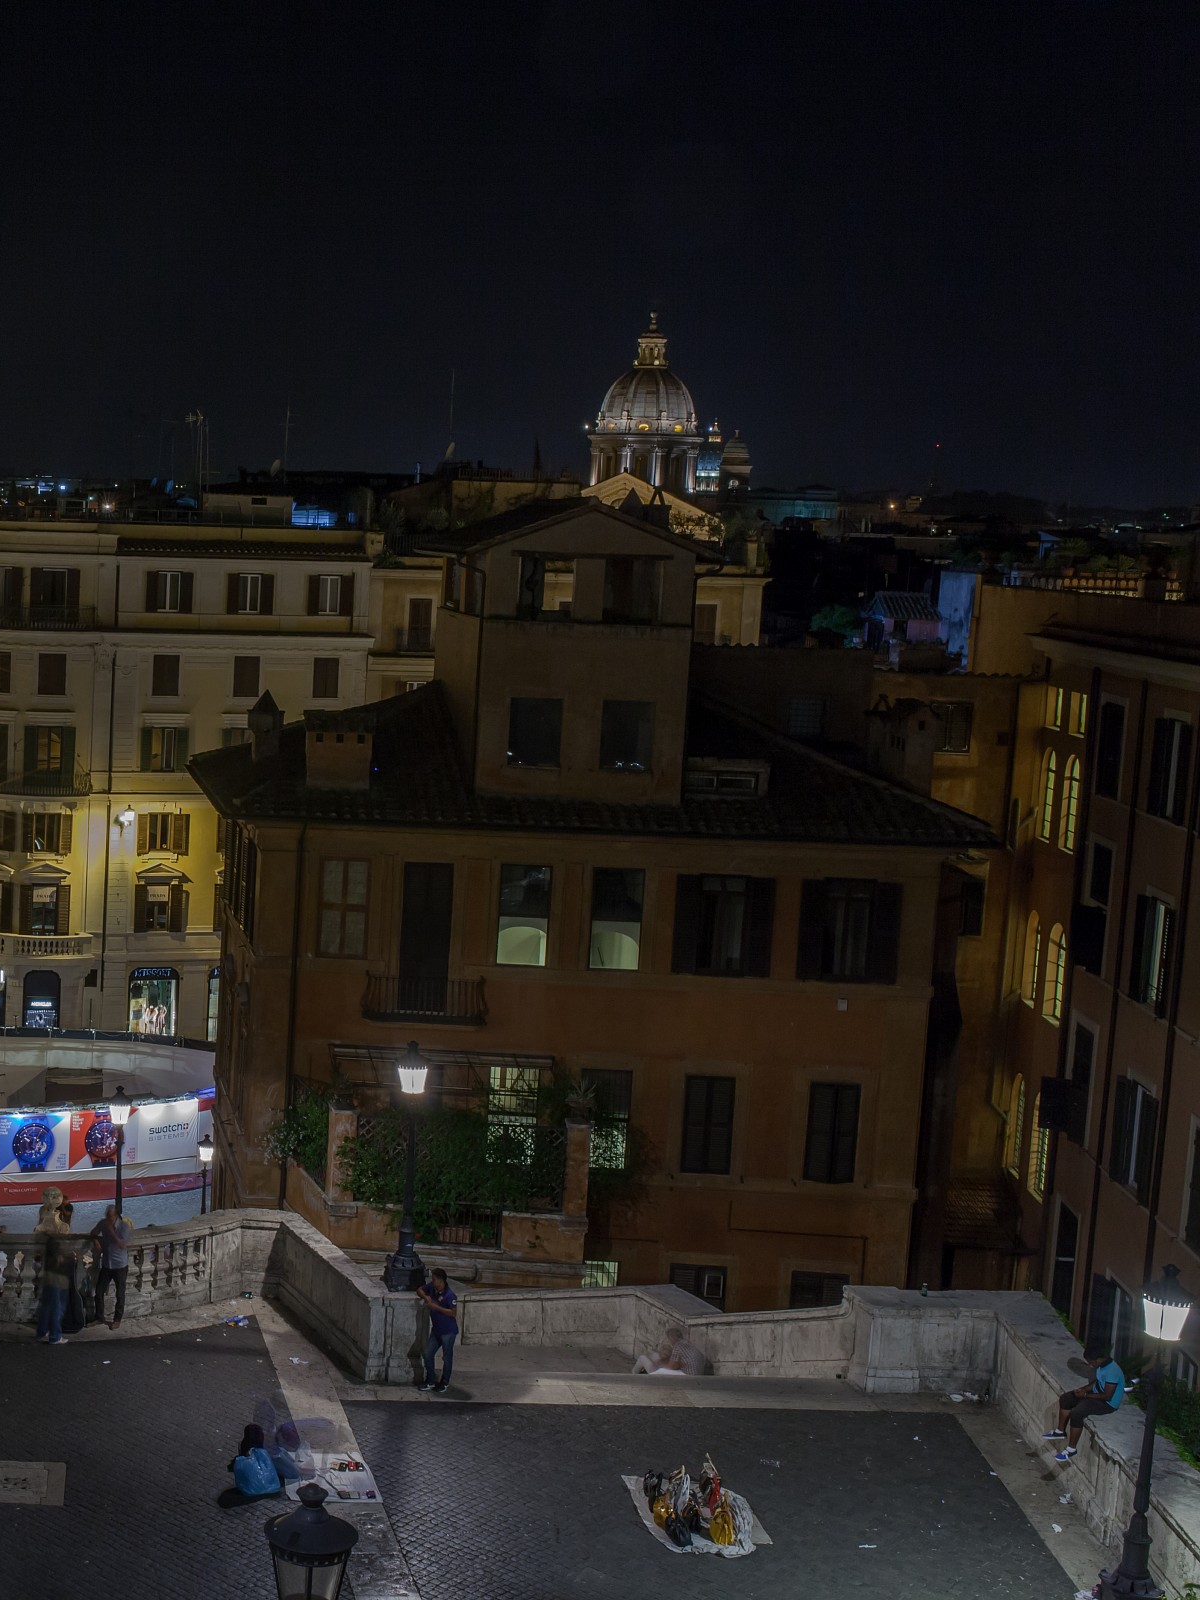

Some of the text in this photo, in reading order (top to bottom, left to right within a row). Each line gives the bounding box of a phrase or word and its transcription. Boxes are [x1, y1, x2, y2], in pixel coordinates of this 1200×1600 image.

[134, 968, 172, 977] MISSONI
[149, 1123, 183, 1135] swatch
[149, 1131, 189, 1142] SISTEM51
